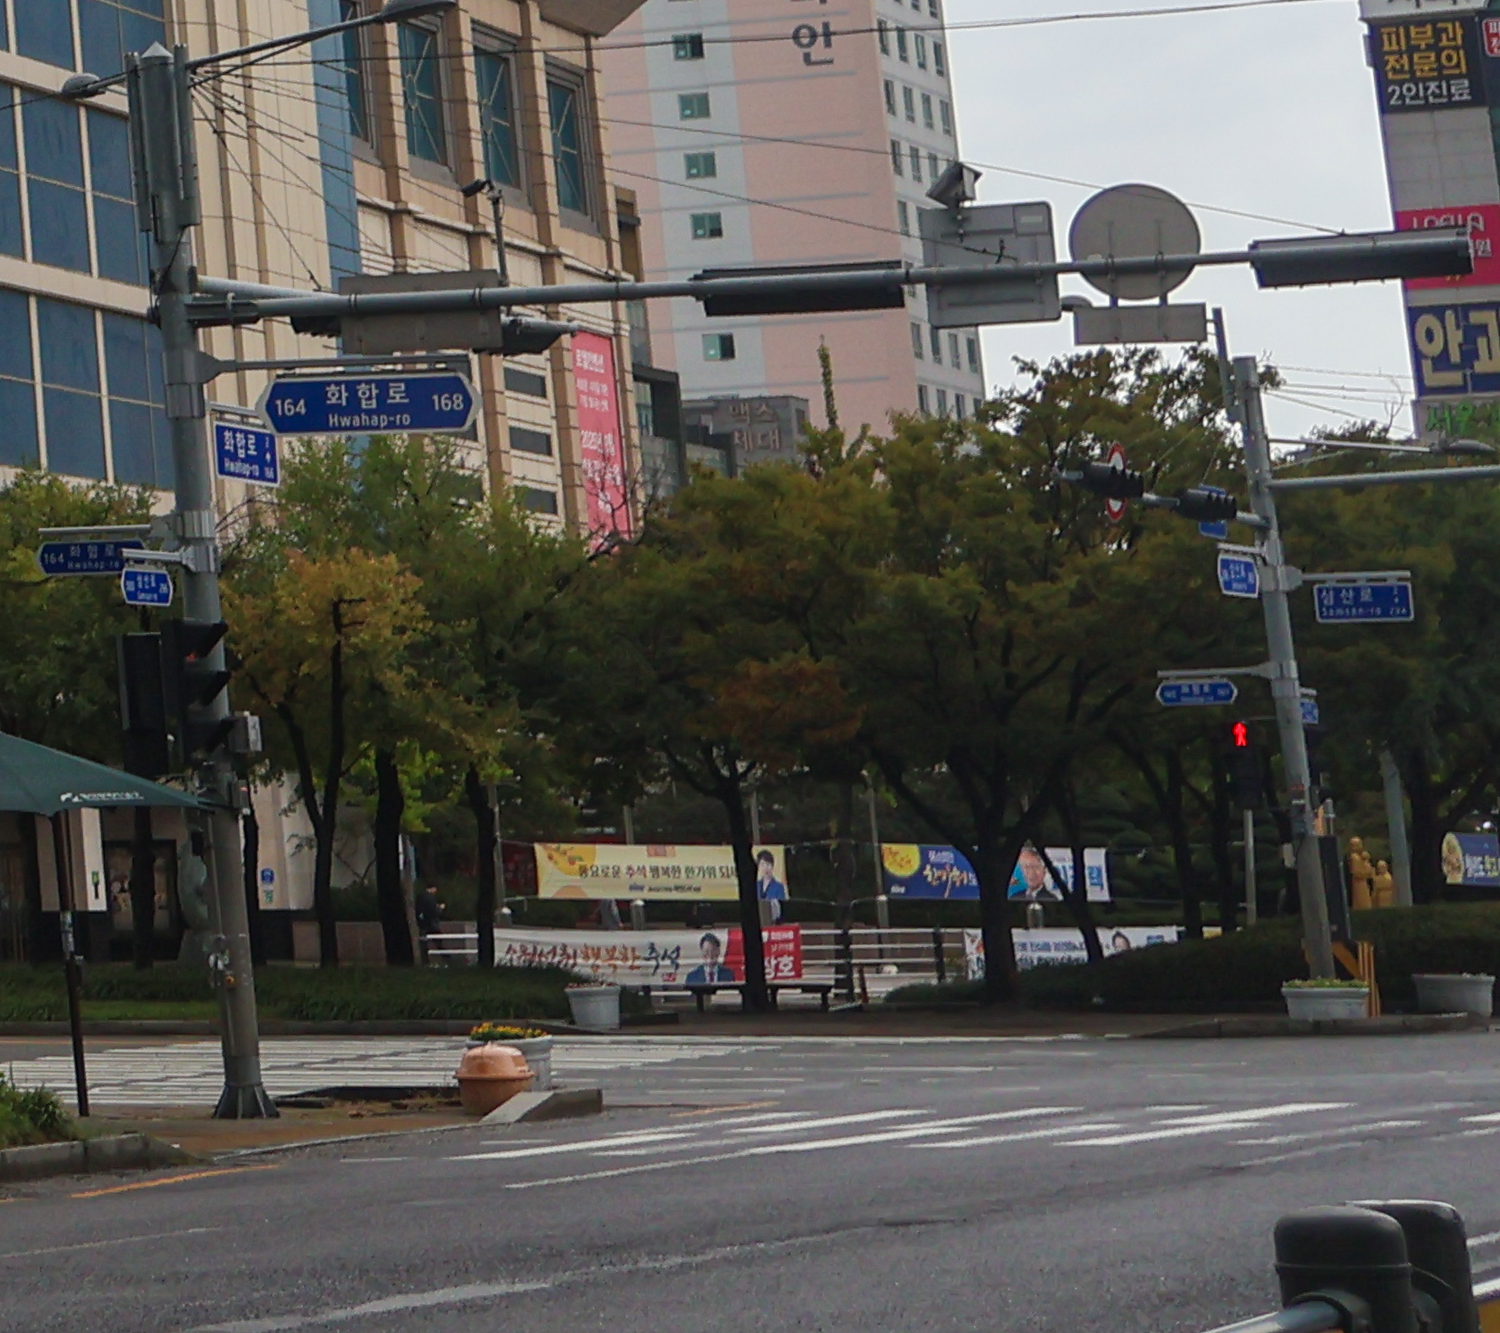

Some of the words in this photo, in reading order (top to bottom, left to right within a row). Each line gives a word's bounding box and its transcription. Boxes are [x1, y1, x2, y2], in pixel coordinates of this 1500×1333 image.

[1380, 21, 1464, 53] 피부과
[1384, 49, 1469, 80] 전문의
[1387, 79, 1473, 106] 2인진료
[274, 398, 307, 417] 164
[325, 382, 409, 410] 화합로
[431, 393, 465, 412] 168
[328, 412, 411, 430] Hwahap-ro
[223, 429, 258, 459] 화합로
[43, 553, 65, 565] 164
[625, 865, 647, 879] 추석
